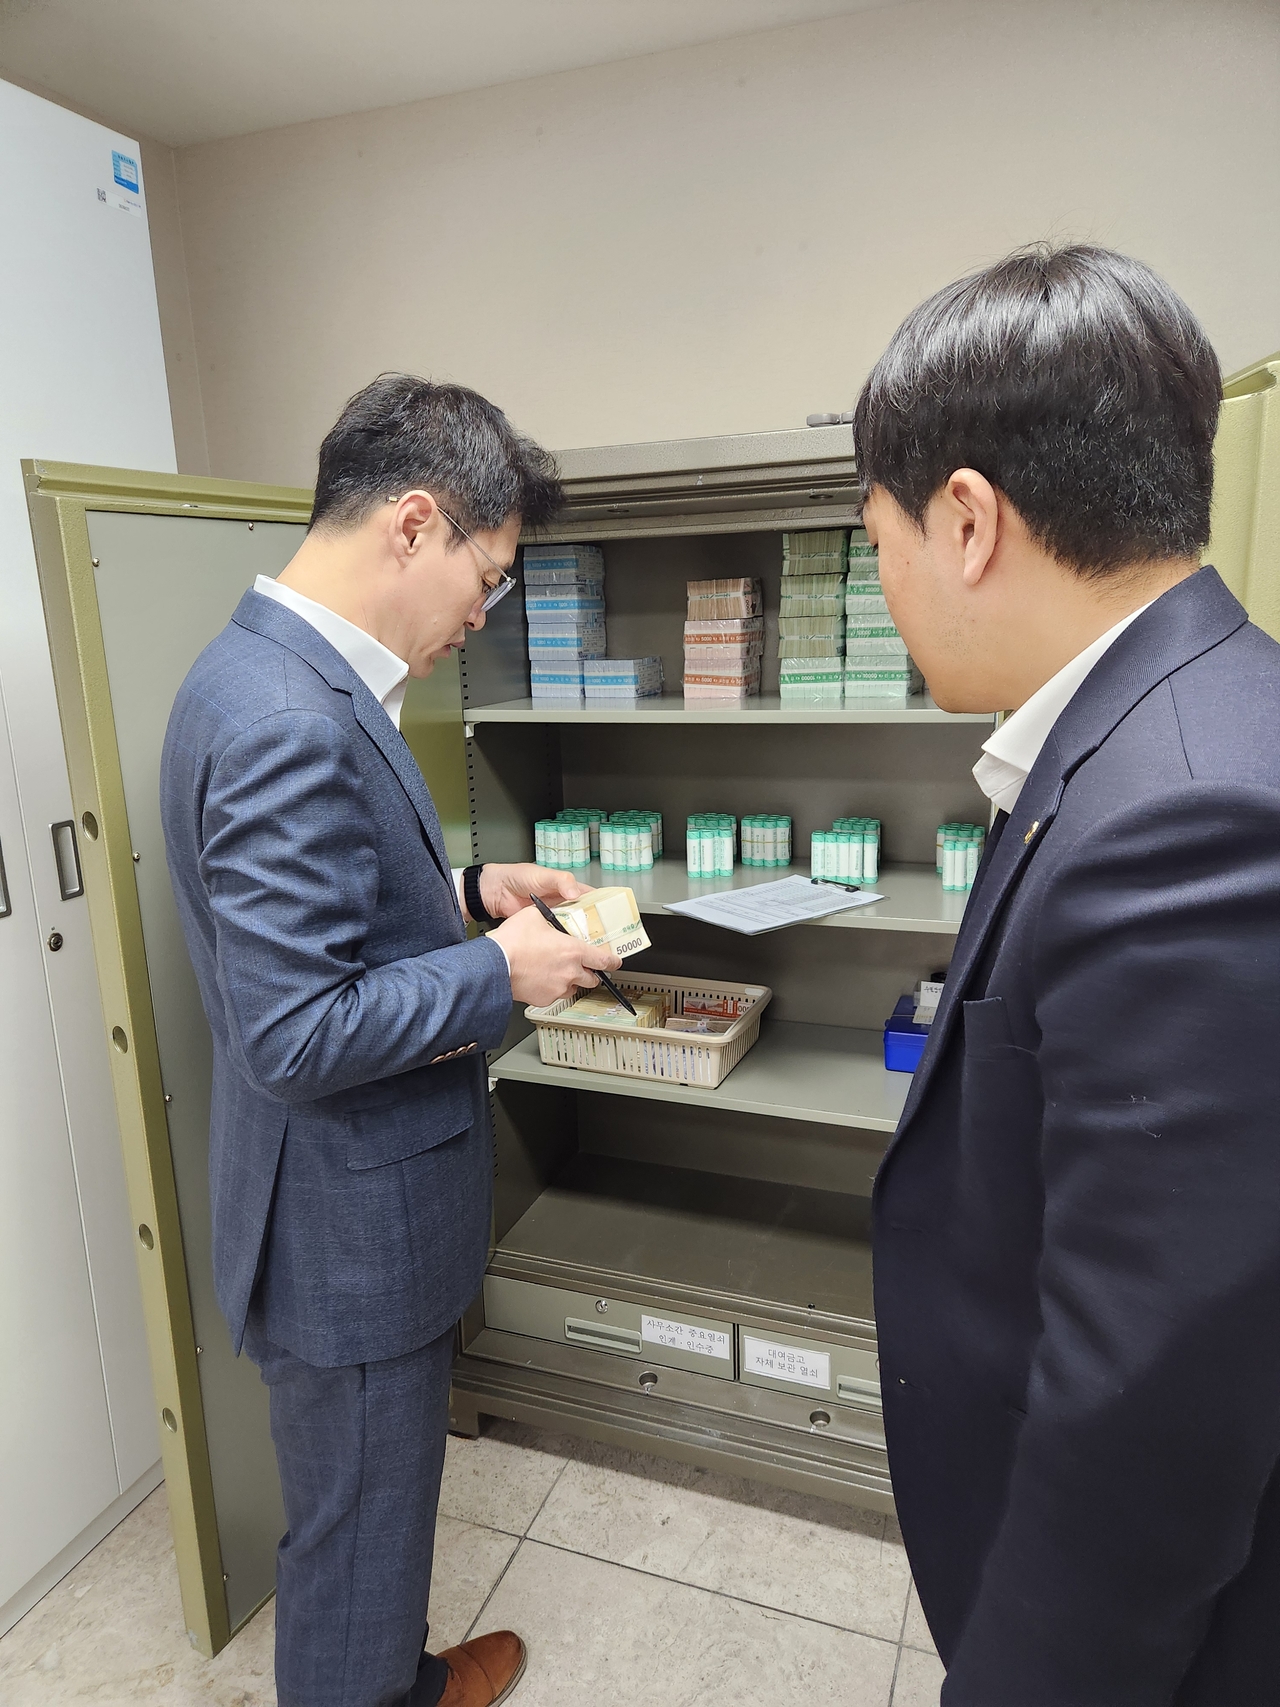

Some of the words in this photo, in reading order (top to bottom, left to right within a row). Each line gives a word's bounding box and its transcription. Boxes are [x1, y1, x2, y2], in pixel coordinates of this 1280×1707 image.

[616, 937, 643, 955] 50000
[647, 1319, 683, 1336] 사무소간
[658, 1334, 676, 1346] 인계
[767, 1348, 805, 1364] 대여금고
[755, 1356, 774, 1369] 자체
[777, 1362, 796, 1373] 보관
[799, 1366, 818, 1378] 열쇠
